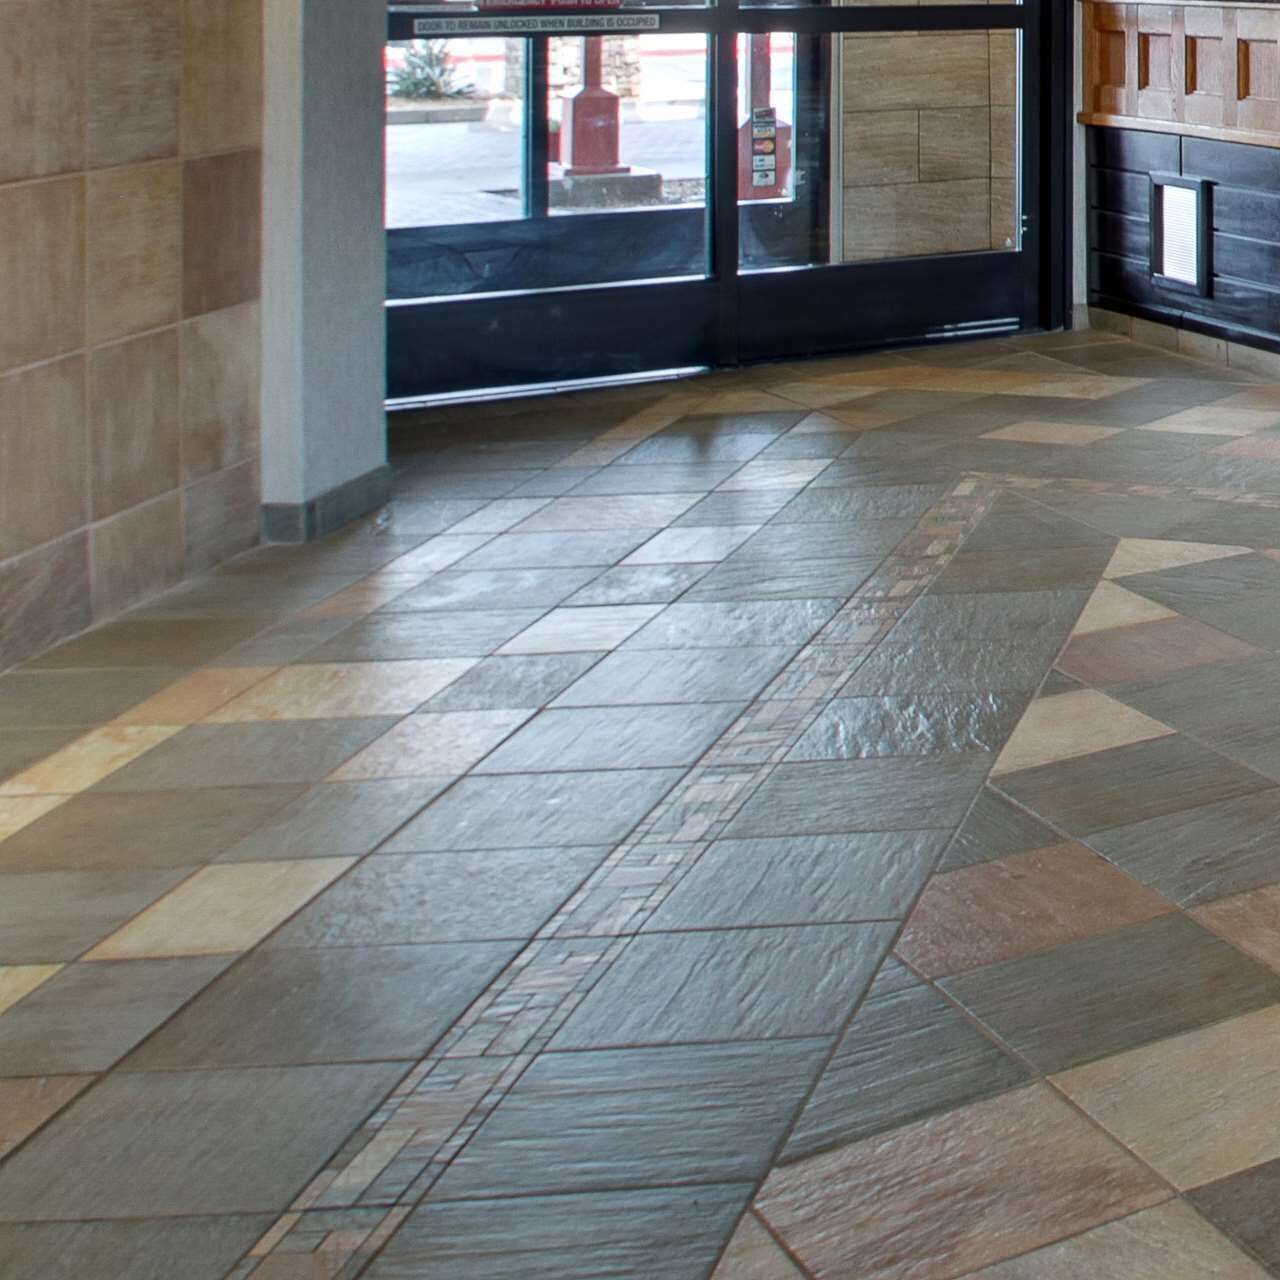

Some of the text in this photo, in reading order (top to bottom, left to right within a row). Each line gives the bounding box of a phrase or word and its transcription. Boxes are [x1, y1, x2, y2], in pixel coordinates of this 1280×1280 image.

[417, 16, 656, 32] DOOR TO REMAIN UNLOCKED WHEN BUILDING IS OCCUPIED
